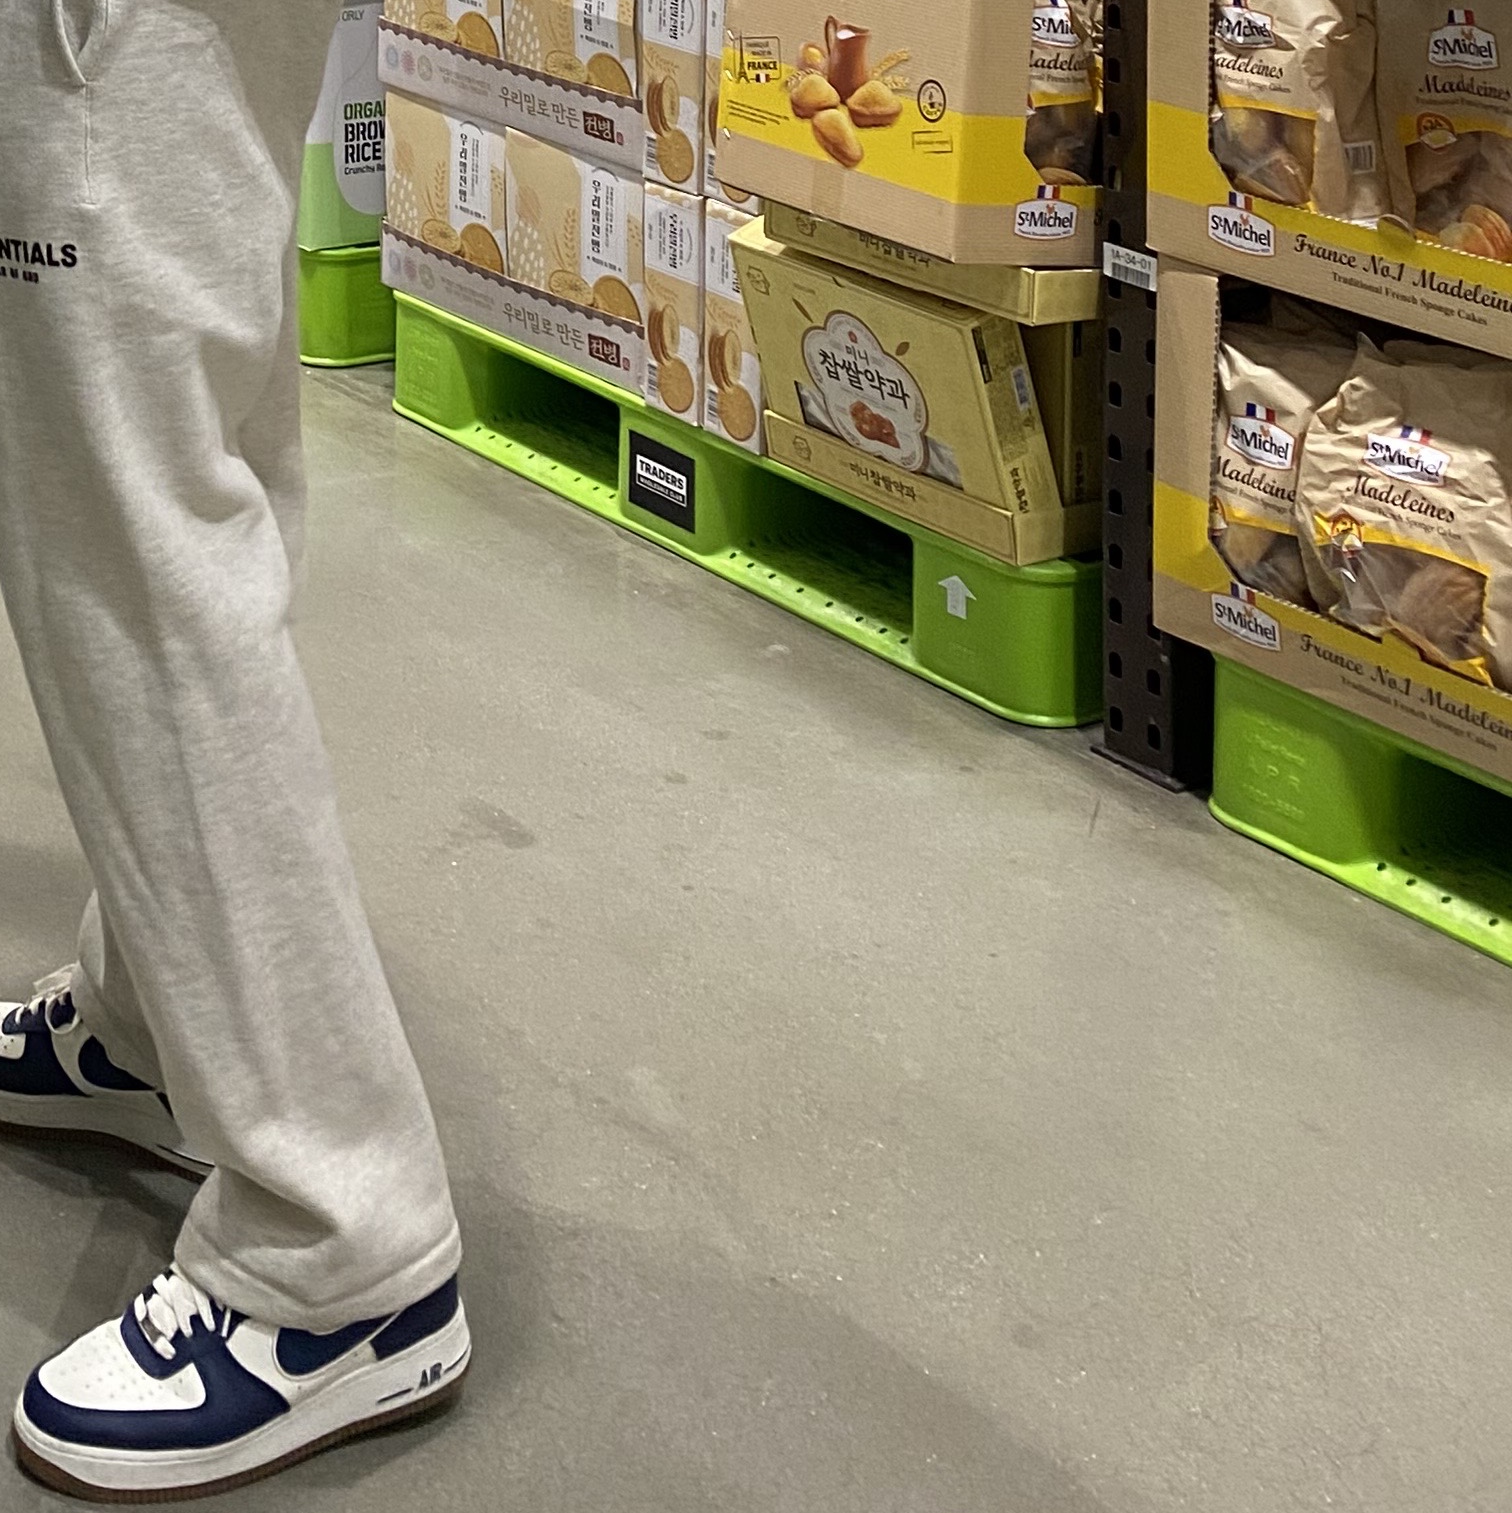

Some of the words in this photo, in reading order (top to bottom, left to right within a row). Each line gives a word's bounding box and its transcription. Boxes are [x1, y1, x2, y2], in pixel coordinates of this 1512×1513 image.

[341, 9, 365, 23] ORLY
[747, 60, 779, 72] FRANCE
[343, 101, 385, 120] ORGA
[498, 86, 551, 118] 우리밀로
[552, 102, 580, 131] 만든
[583, 114, 615, 143] 전병
[344, 140, 382, 165] RICE
[1294, 233, 1357, 269] France
[1362, 254, 1406, 283] No.1
[1420, 295, 1456, 319] Sponge
[1457, 307, 1488, 326] Cakes
[502, 301, 555, 335] 우리밀로
[556, 318, 586, 351] 만든
[588, 335, 620, 368] 전병
[845, 343, 870, 363] 미니
[818, 347, 911, 411] 찹쌀약과
[638, 459, 684, 491] TRADERS
[1345, 473, 1456, 524] Madeleines
[1299, 633, 1364, 676] France
[419, 1361, 444, 1389] AIR
